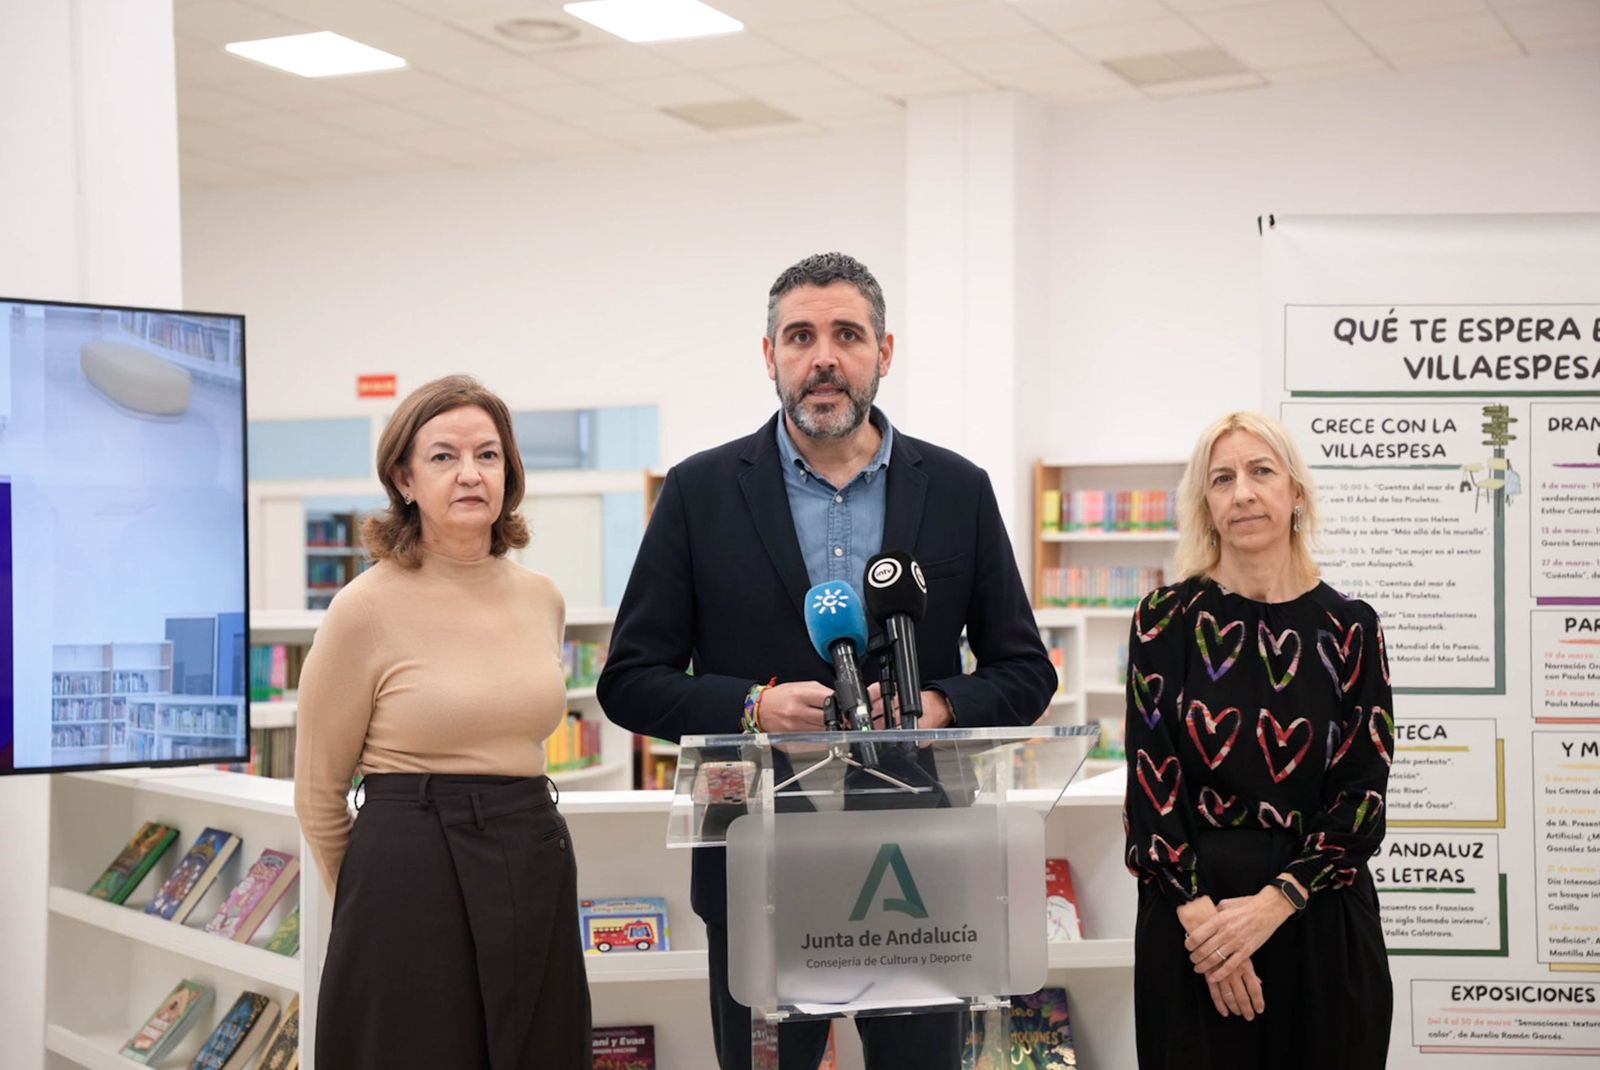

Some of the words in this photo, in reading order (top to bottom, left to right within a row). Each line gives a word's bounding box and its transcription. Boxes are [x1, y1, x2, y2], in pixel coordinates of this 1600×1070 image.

[1333, 308, 1398, 345] QUÉ
[1410, 318, 1447, 343] TE
[1458, 317, 1581, 343] ESPERA
[1311, 418, 1375, 434] CRECE
[1381, 417, 1426, 434] CON
[1432, 418, 1457, 433] LA
[1321, 443, 1446, 459] VILLAESPESA
[1356, 495, 1377, 503] Árbol
[1370, 528, 1389, 536] obra
[1431, 528, 1441, 536] de
[1443, 528, 1451, 536] la
[1552, 526, 1562, 534] de
[1411, 549, 1433, 557] mujer
[1553, 559, 1563, 567] de
[1456, 655, 1490, 663] Saldaña
[1545, 662, 1586, 670] Narración
[1545, 700, 1568, 708] Paula
[1562, 742, 1574, 758] Y
[1581, 741, 1599, 758] M
[1545, 787, 1557, 795] los
[1559, 787, 1591, 795] Centros
[1546, 819, 1556, 827] de
[1389, 842, 1484, 859] ANDALUZ
[1392, 867, 1465, 883] LETRAS
[1560, 890, 1589, 900] bosque
[1435, 904, 1475, 912] Francisco
[1548, 903, 1580, 912] Castilla
[1395, 916, 1415, 926] siglo
[1416, 916, 1450, 925] llamado
[801, 932, 853, 950] Junta
[858, 930, 882, 947] de
[886, 924, 978, 946] Andalucía
[1549, 950, 1584, 958] Mantilla
[806, 956, 861, 970] Consejería
[864, 954, 878, 968] de
[880, 954, 919, 966] Cultura
[921, 956, 928, 967] y
[930, 952, 972, 966] Deporte
[1451, 986, 1596, 1003] EXPOSICIONES
[1474, 1018, 1485, 1026] de
[1502, 1032, 1530, 1040] Ramón
[611, 1039, 618, 1048] y
[620, 1036, 646, 1046] Evan
